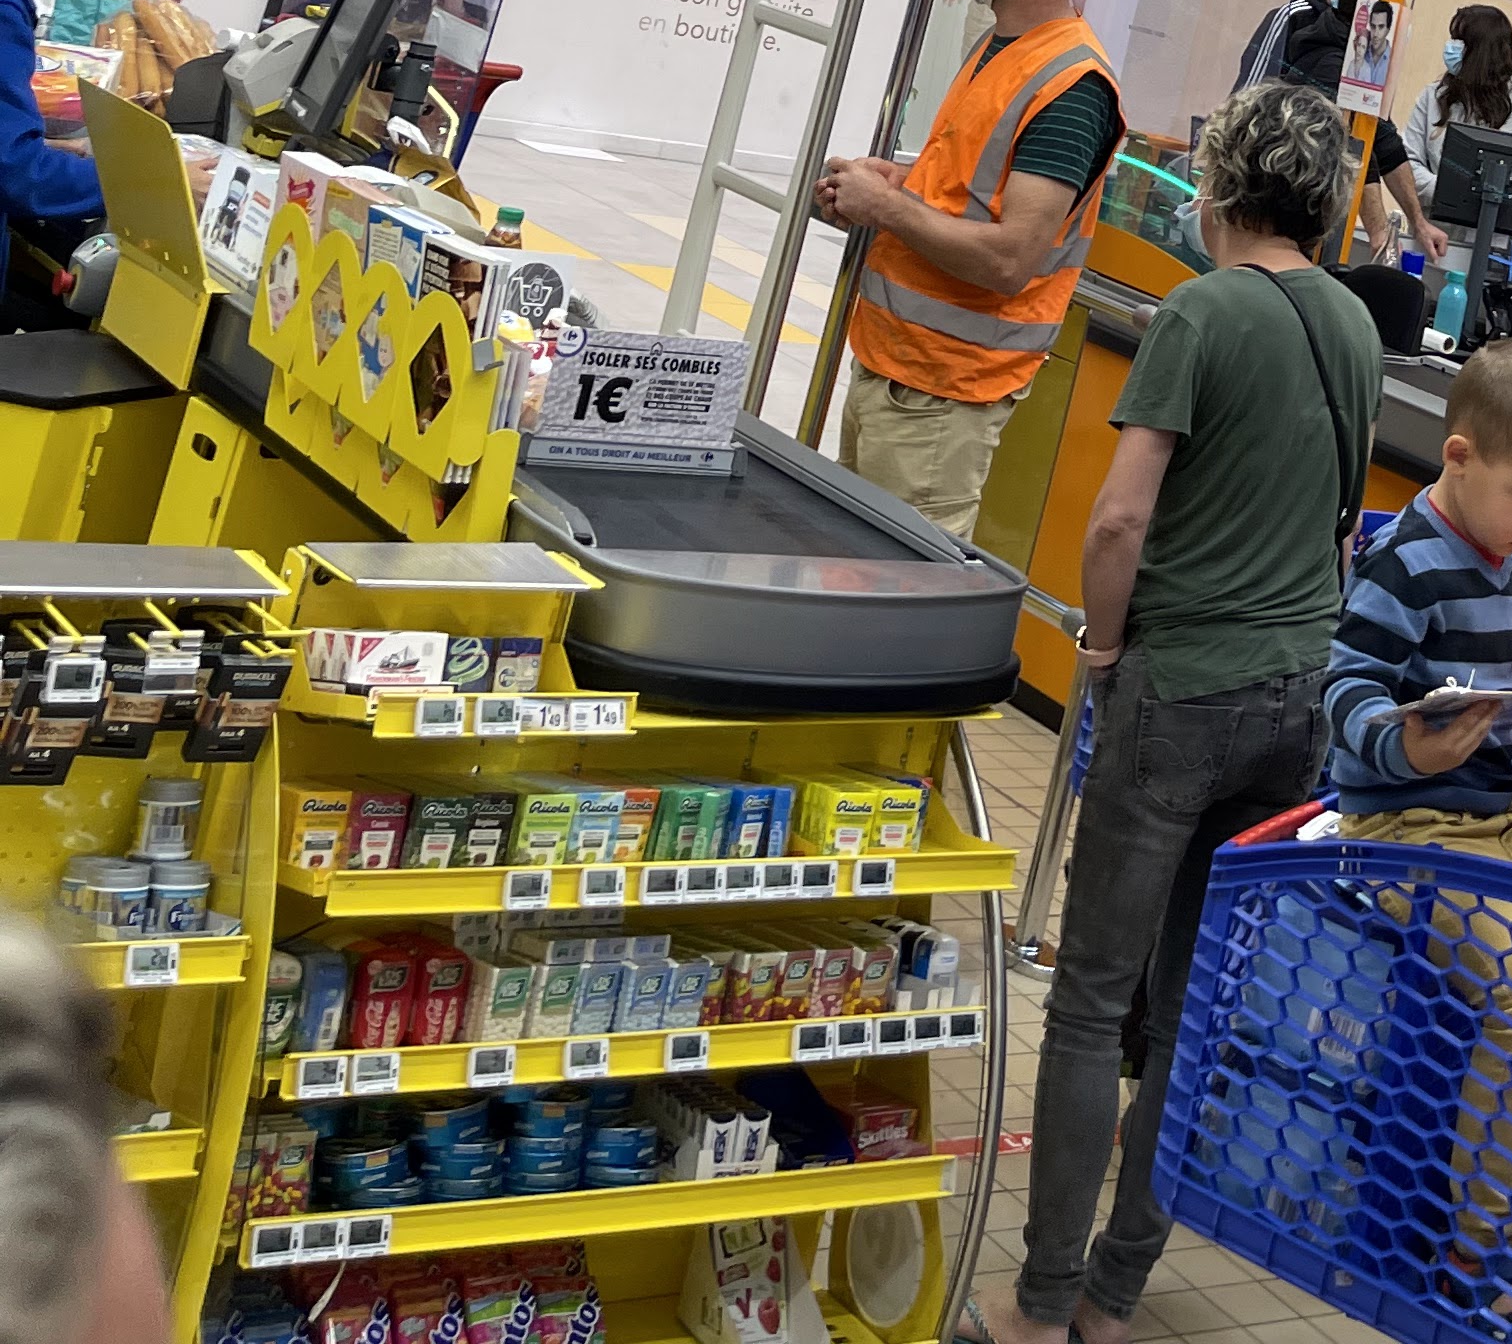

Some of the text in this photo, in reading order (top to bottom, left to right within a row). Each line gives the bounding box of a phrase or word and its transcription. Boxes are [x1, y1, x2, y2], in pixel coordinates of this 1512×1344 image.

[638, 14, 781, 52] en boutie.
[582, 351, 721, 375] ISOLER SES COMBLES
[302, 799, 348, 813] Ricola
[361, 801, 406, 816] Ricola
[423, 802, 468, 818] Ricola
[529, 801, 571, 814] Ricola
[579, 800, 619, 814] Ricola
[836, 800, 873, 813] Ricola
[881, 798, 917, 811] Ricola
